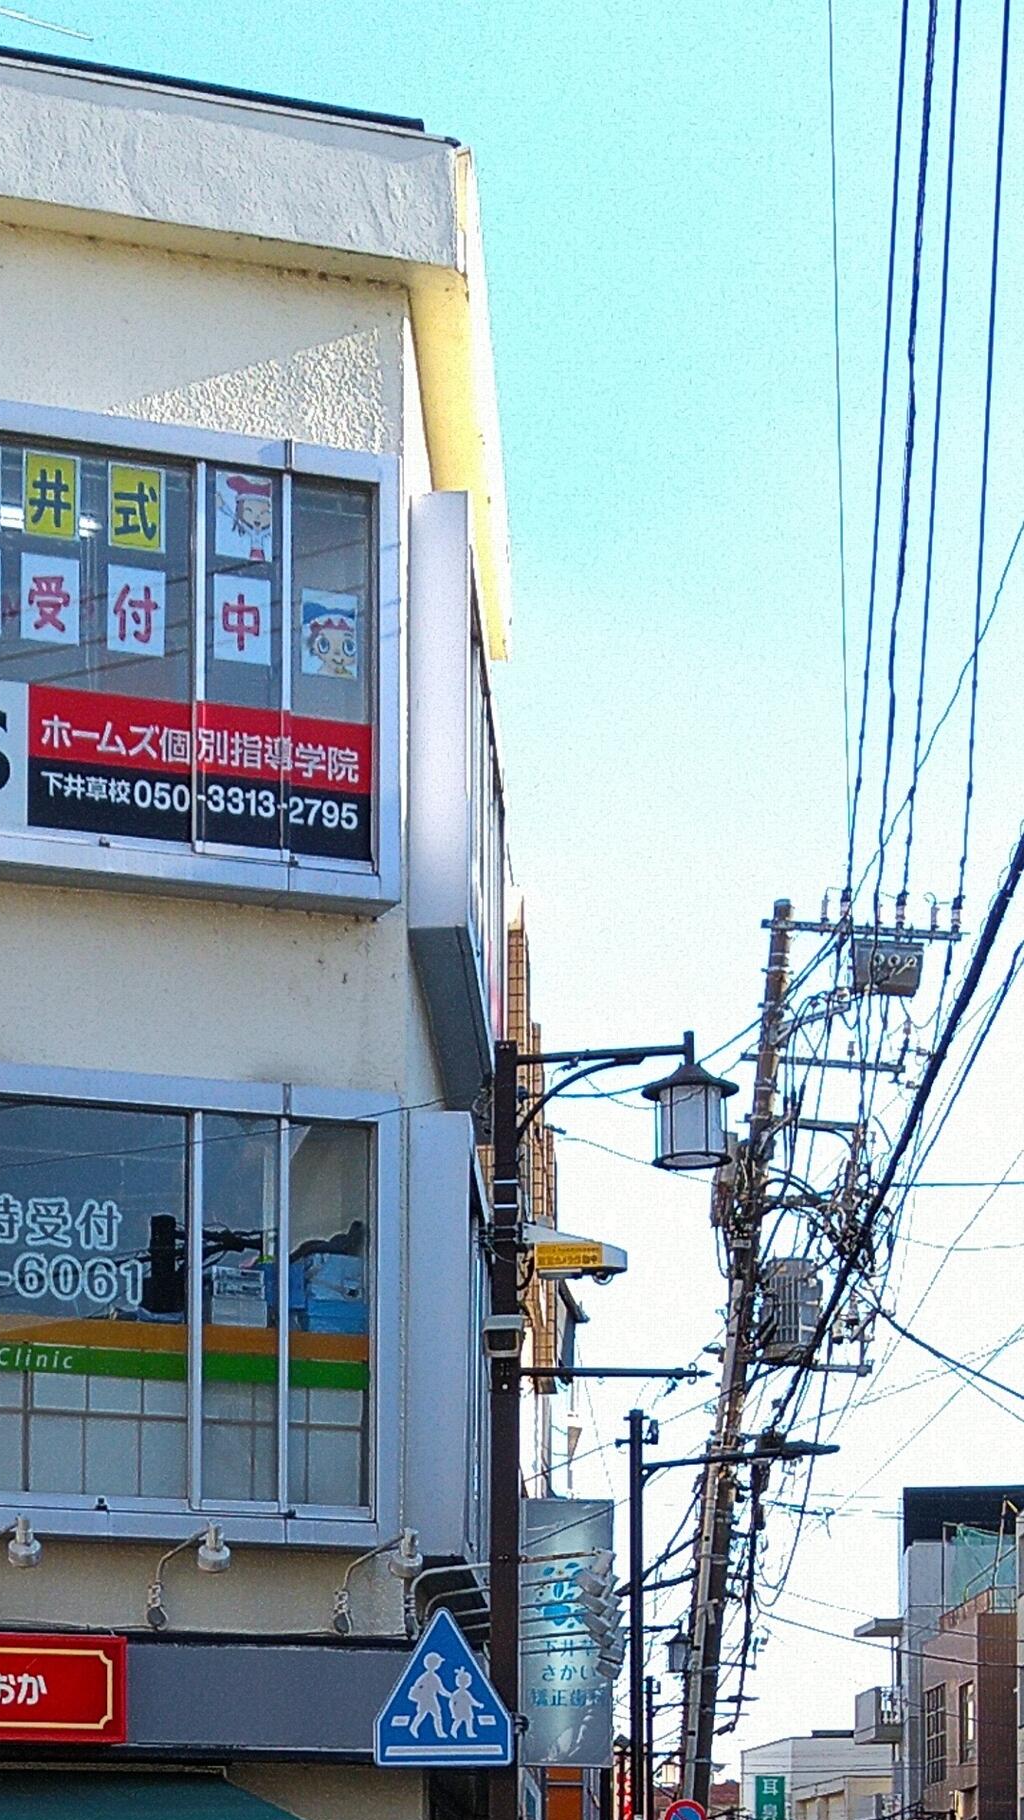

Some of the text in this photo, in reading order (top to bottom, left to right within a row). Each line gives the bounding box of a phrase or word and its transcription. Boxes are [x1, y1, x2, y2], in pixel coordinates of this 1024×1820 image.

[40, 713, 360, 784] ホームズ個別指導学院
[39, 770, 132, 805] 下井草校
